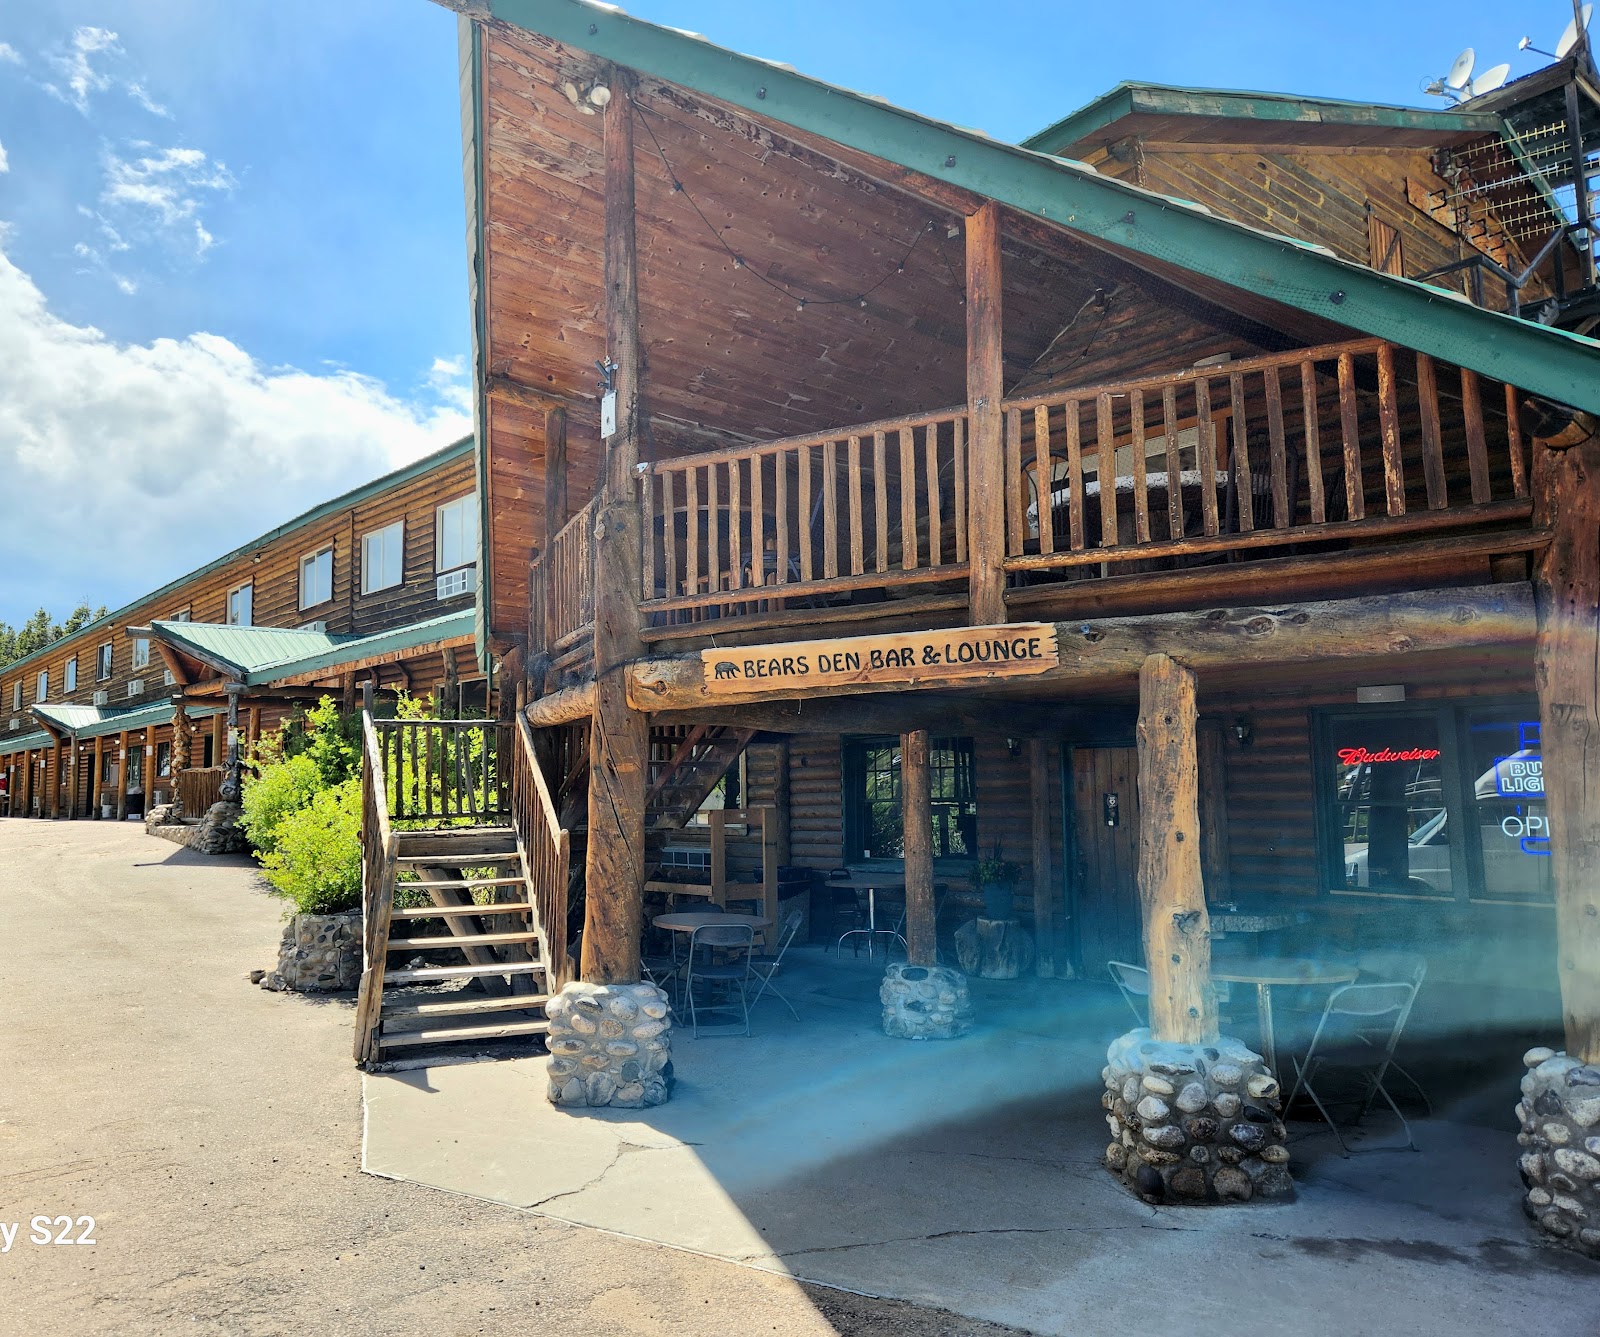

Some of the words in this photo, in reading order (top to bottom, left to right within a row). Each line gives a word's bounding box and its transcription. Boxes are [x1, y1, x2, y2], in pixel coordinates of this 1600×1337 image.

[743, 656, 810, 679] BEARS
[818, 652, 861, 674] DEN
[869, 647, 916, 670] BAR
[921, 644, 942, 666] &
[945, 637, 1043, 664] LOUNGE
[1337, 747, 1441, 766] Budweiser
[1509, 761, 1543, 777] BU
[1501, 776, 1545, 792] LIG
[1501, 815, 1550, 837] OP
